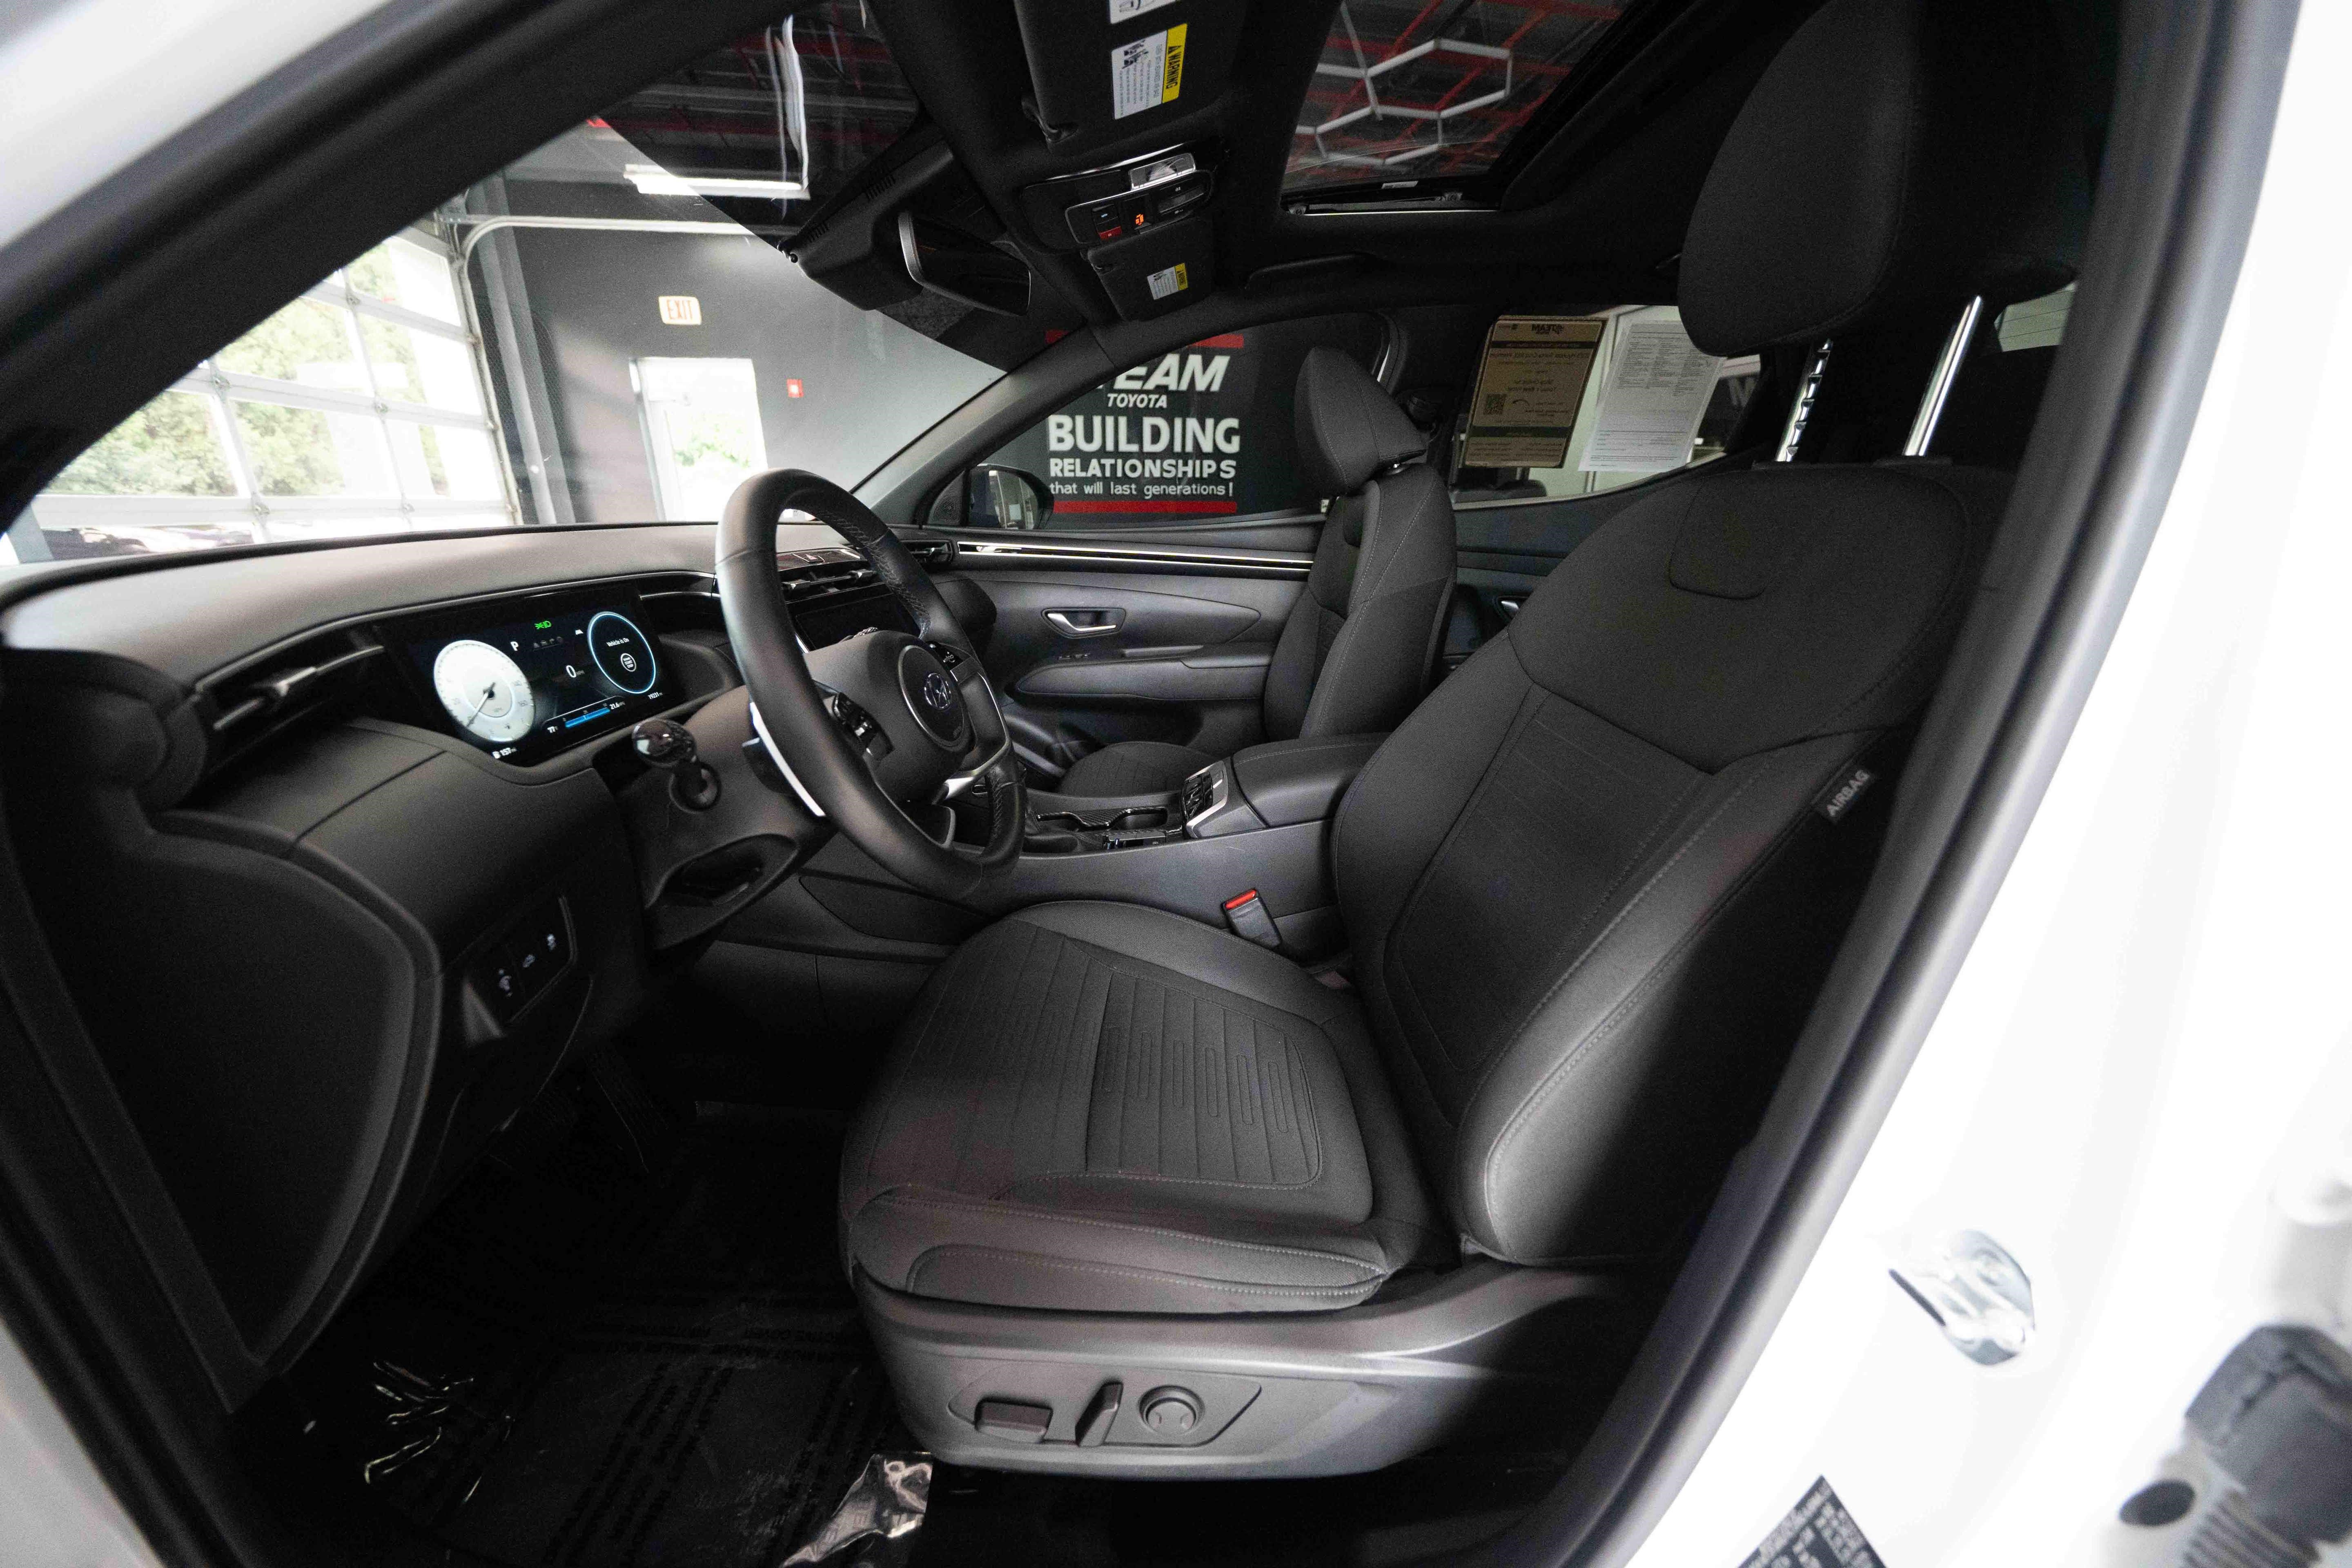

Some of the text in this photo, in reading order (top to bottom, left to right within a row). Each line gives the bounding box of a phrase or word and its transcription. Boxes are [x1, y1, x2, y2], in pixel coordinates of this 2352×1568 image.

[1165, 52, 1181, 90] WARNING
[666, 299, 693, 320] EXIT
[1097, 353, 1230, 392] EAM
[1107, 393, 1167, 408] TOYOTA
[1047, 414, 1240, 453] BUILDING
[1049, 458, 1236, 479] RELATIONSHIPS
[1049, 481, 1078, 494] that
[1083, 481, 1103, 494] will
[1110, 481, 1137, 494] last
[510, 641, 519, 651] P
[606, 639, 621, 647] Vehicle
[566, 665, 577, 678] 0
[499, 747, 511, 756] 157
[1826, 770, 1870, 816] AIRBAG
